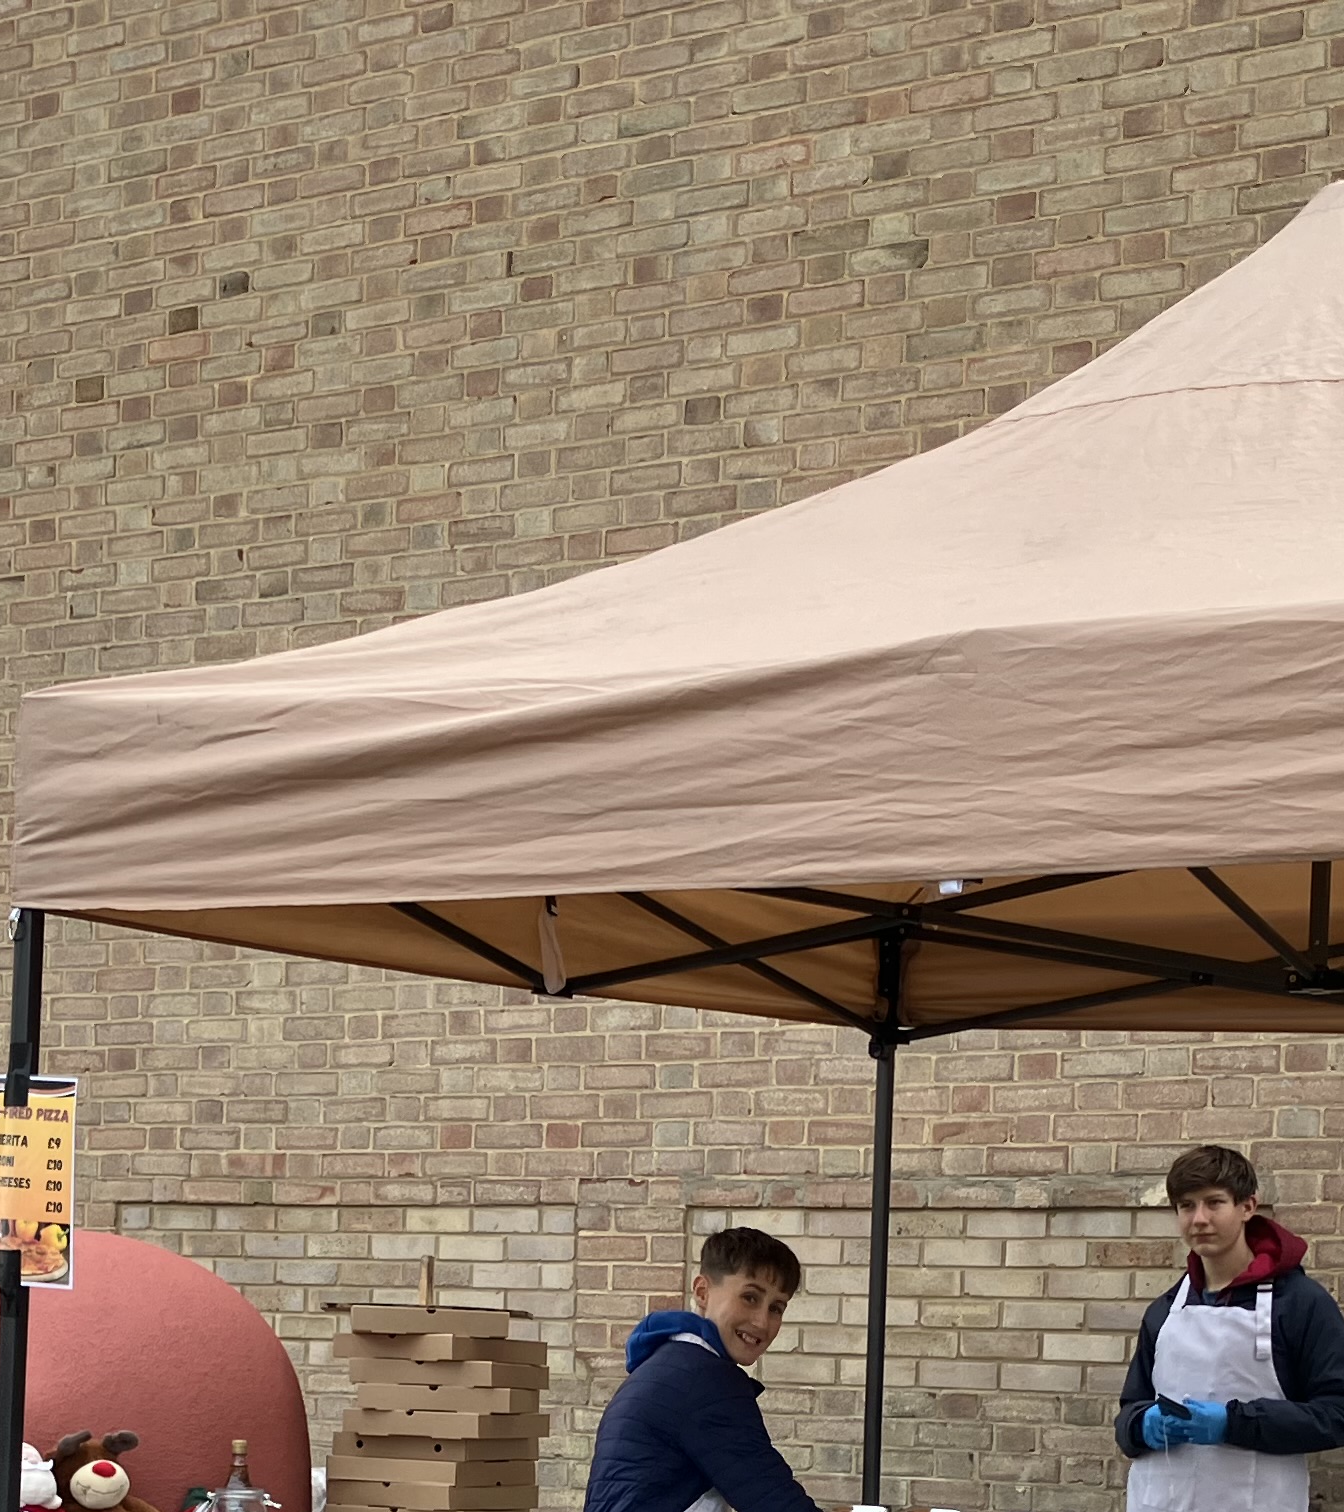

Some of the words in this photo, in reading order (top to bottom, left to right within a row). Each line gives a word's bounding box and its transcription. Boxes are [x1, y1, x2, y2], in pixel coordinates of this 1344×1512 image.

[36, 1108, 69, 1123] PIZZA
[47, 1137, 62, 1150] £9
[46, 1159, 63, 1172] £10
[45, 1179, 63, 1192] £10
[45, 1201, 63, 1214] £10
